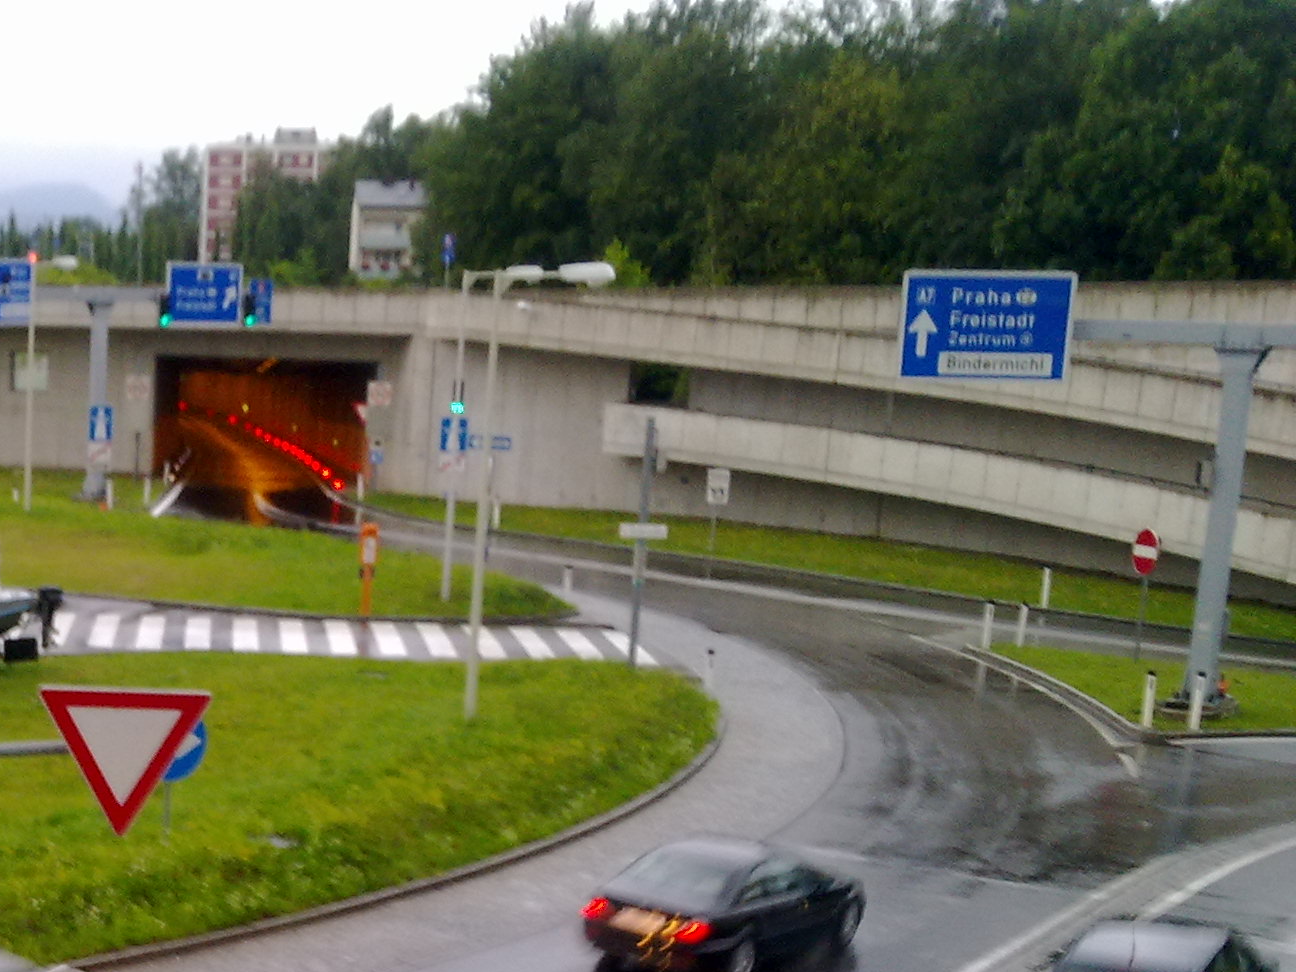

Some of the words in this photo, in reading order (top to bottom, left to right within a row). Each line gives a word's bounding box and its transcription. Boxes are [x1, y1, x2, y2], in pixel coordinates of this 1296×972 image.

[952, 287, 1011, 306] Praha
[949, 309, 1036, 330] Freistadt
[948, 330, 1016, 348] Zentrum
[946, 355, 1045, 372] Bindermichl
